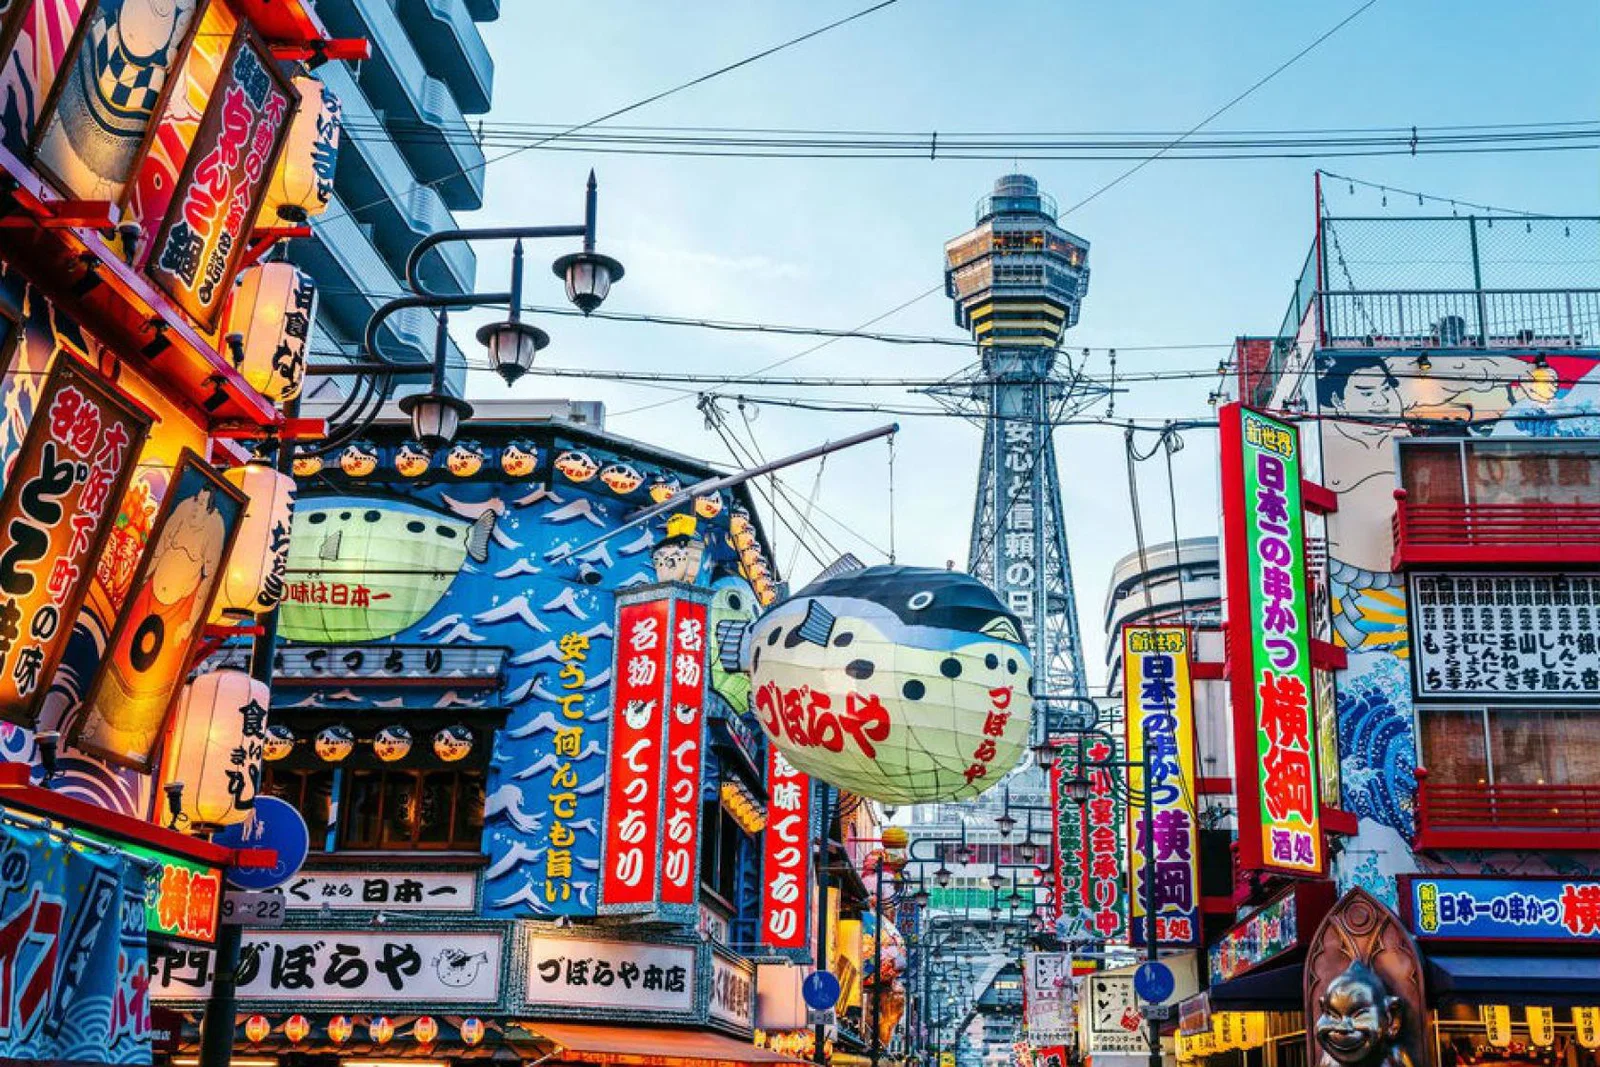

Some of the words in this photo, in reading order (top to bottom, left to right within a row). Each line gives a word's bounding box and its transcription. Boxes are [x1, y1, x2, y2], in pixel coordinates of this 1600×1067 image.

[51, 386, 100, 457] 名物
[1246, 416, 1293, 459] 新世界
[13, 422, 129, 697] 大阪下町の味
[1256, 453, 1297, 671] 日本一の串かつ
[1480, 632, 1500, 691] にんにく
[1500, 633, 1520, 690] 玉ねぎ
[1519, 633, 1540, 690] 山芋
[1557, 632, 1580, 690] れんこん
[545, 631, 590, 902] 安うて何んでも旨い
[1259, 670, 1313, 827] 横綱
[1272, 828, 1314, 866] 酒処
[159, 865, 219, 937] 横綱
[1438, 892, 1560, 925] 日本一の串かつ
[538, 957, 686, 993] づぼらや本店
